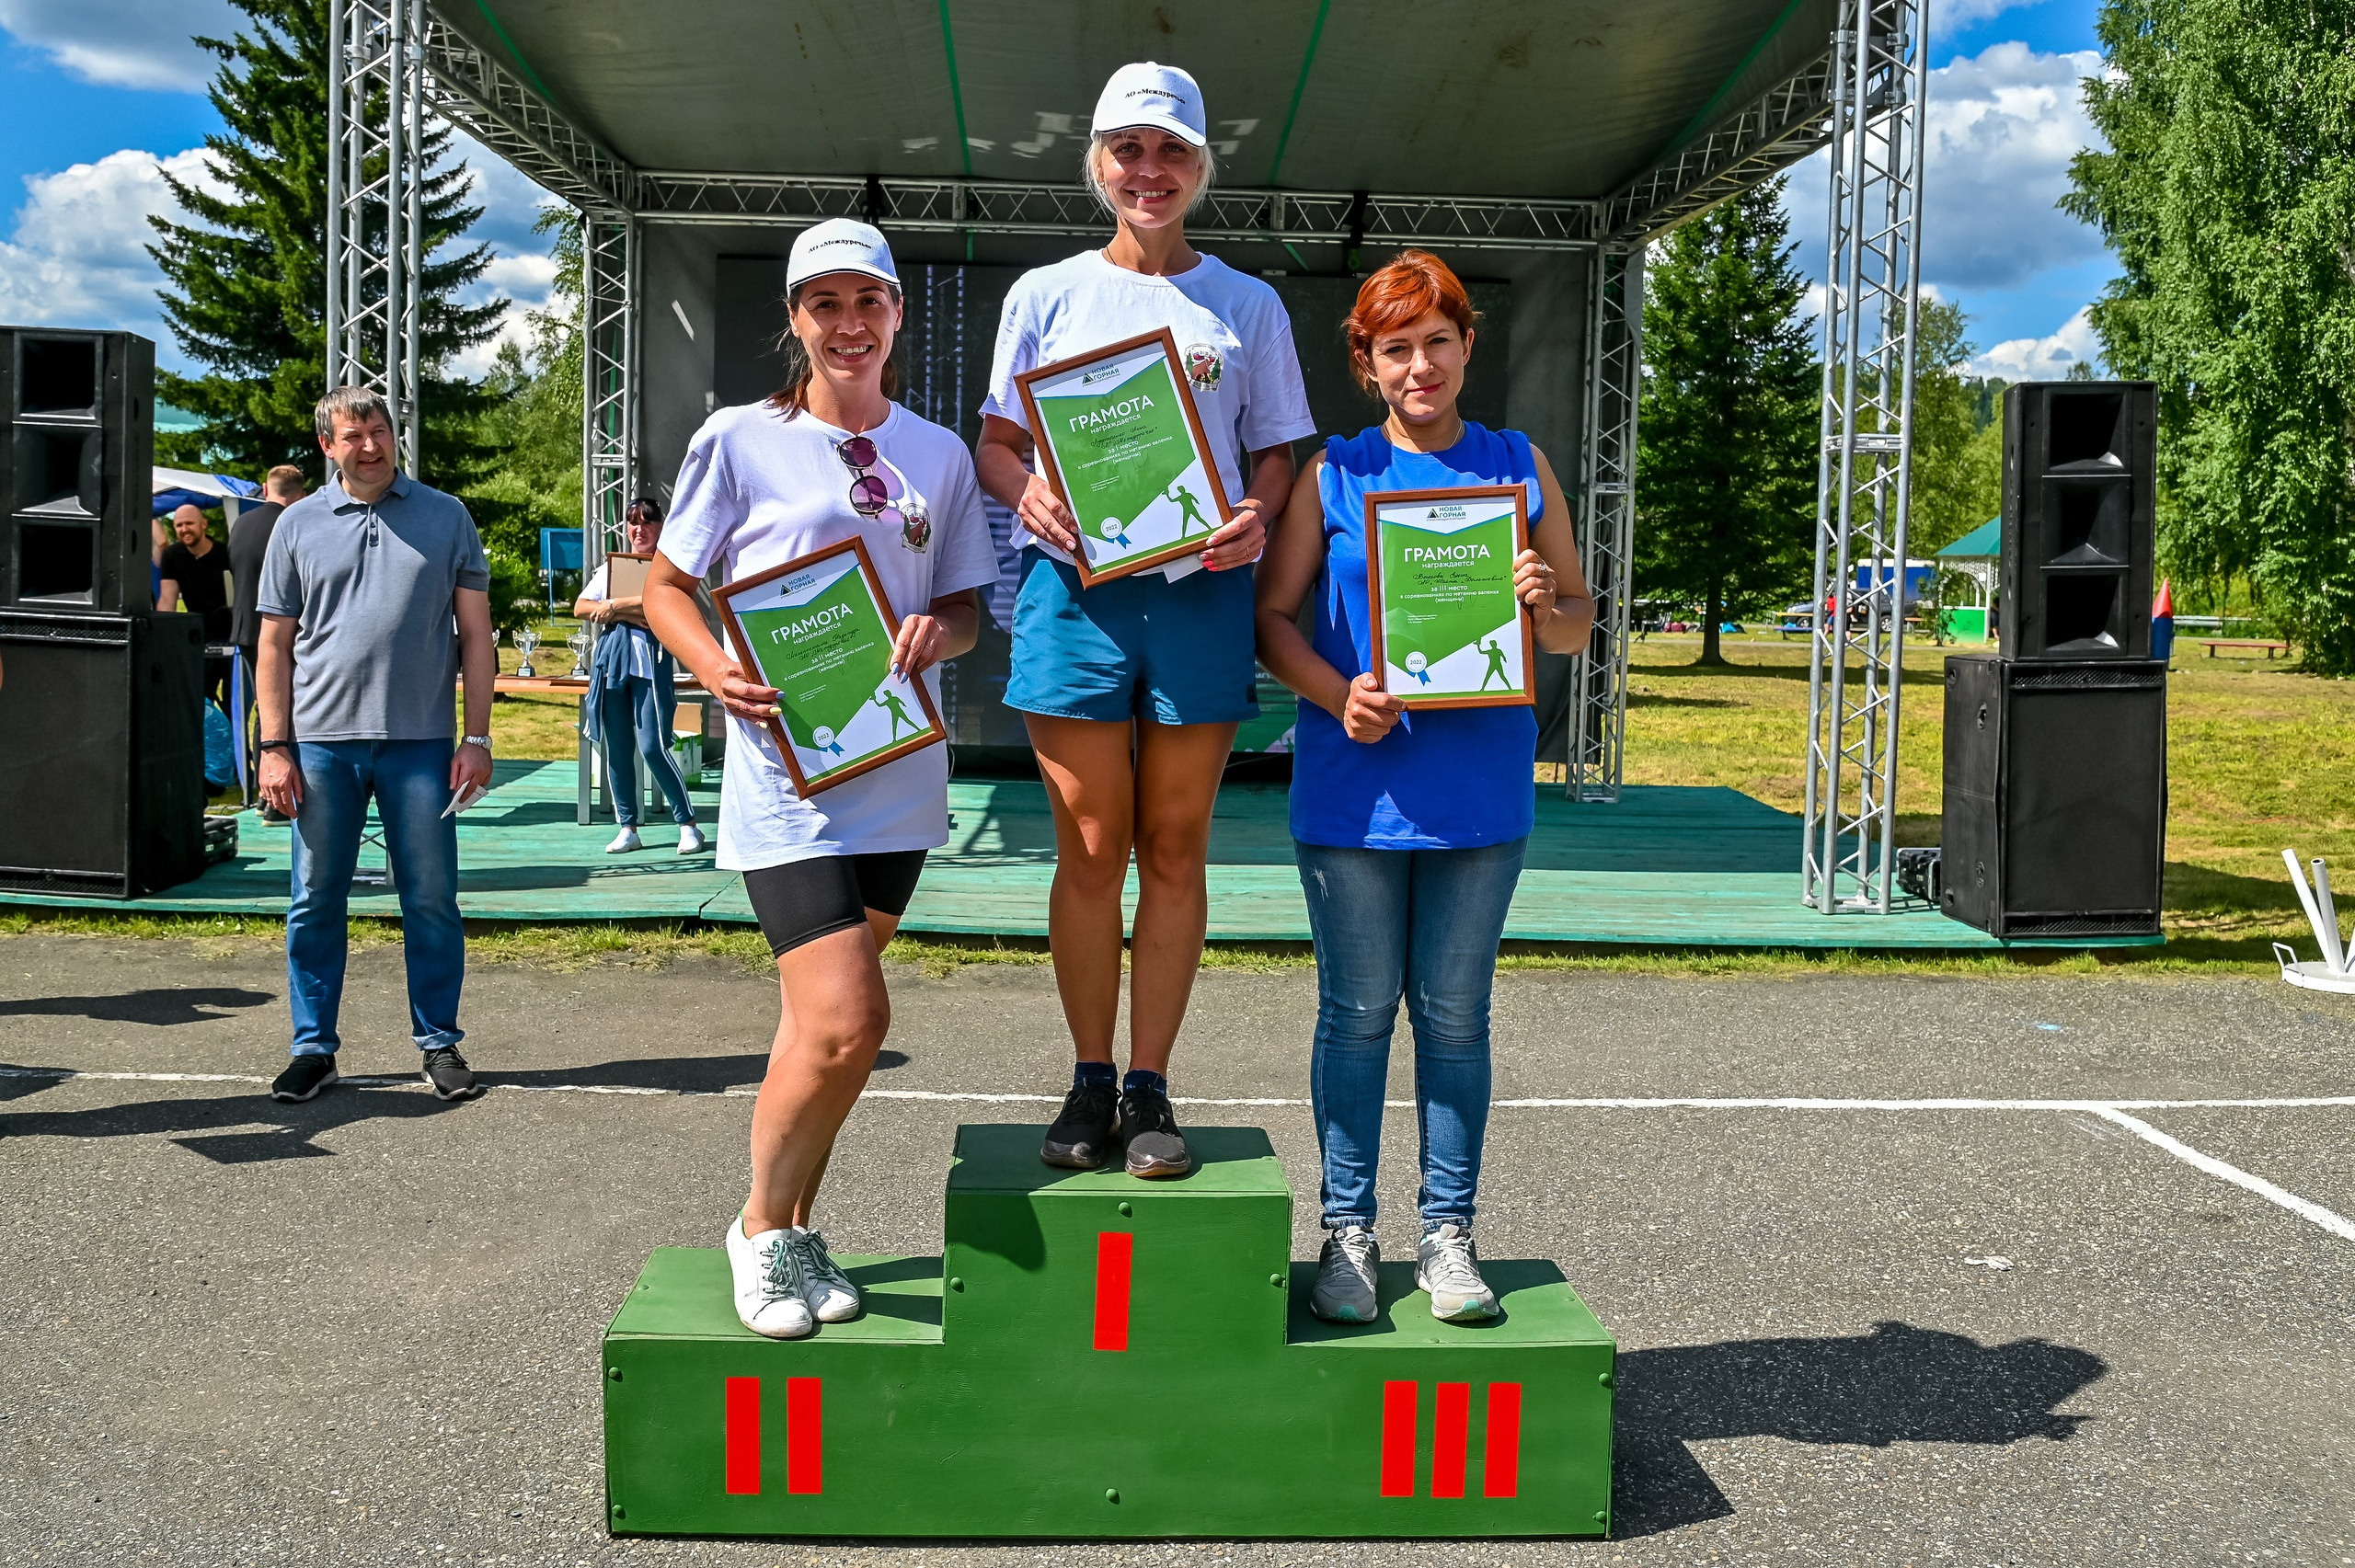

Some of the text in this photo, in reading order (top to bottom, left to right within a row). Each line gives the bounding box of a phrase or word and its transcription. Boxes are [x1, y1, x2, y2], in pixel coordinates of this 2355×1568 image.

[1091, 363, 1114, 373] НОВАЯ
[1093, 368, 1120, 380] ГОРНАЯ
[1069, 395, 1155, 433] ГРАМОТА
[1090, 414, 1141, 434] награждается
[1082, 453, 1121, 469] соревнованиях
[1129, 442, 1152, 452] метанию
[1152, 436, 1173, 445] валенка
[1120, 441, 1139, 450] место
[1404, 544, 1490, 563] ГРАМОТА
[1421, 560, 1475, 569] награждается
[788, 574, 810, 586] НОВАЯ
[791, 578, 816, 591] ГОРНАЯ
[770, 602, 854, 645] ГРАМОТА
[793, 622, 842, 645] награждается
[787, 662, 825, 680] соревнованиях
[833, 649, 855, 661] метанию
[855, 642, 875, 652] валенка
[824, 647, 844, 658] место
[818, 733, 829, 741] 2022
[725, 1376, 821, 1494] II
[1381, 1380, 1521, 1498] III
